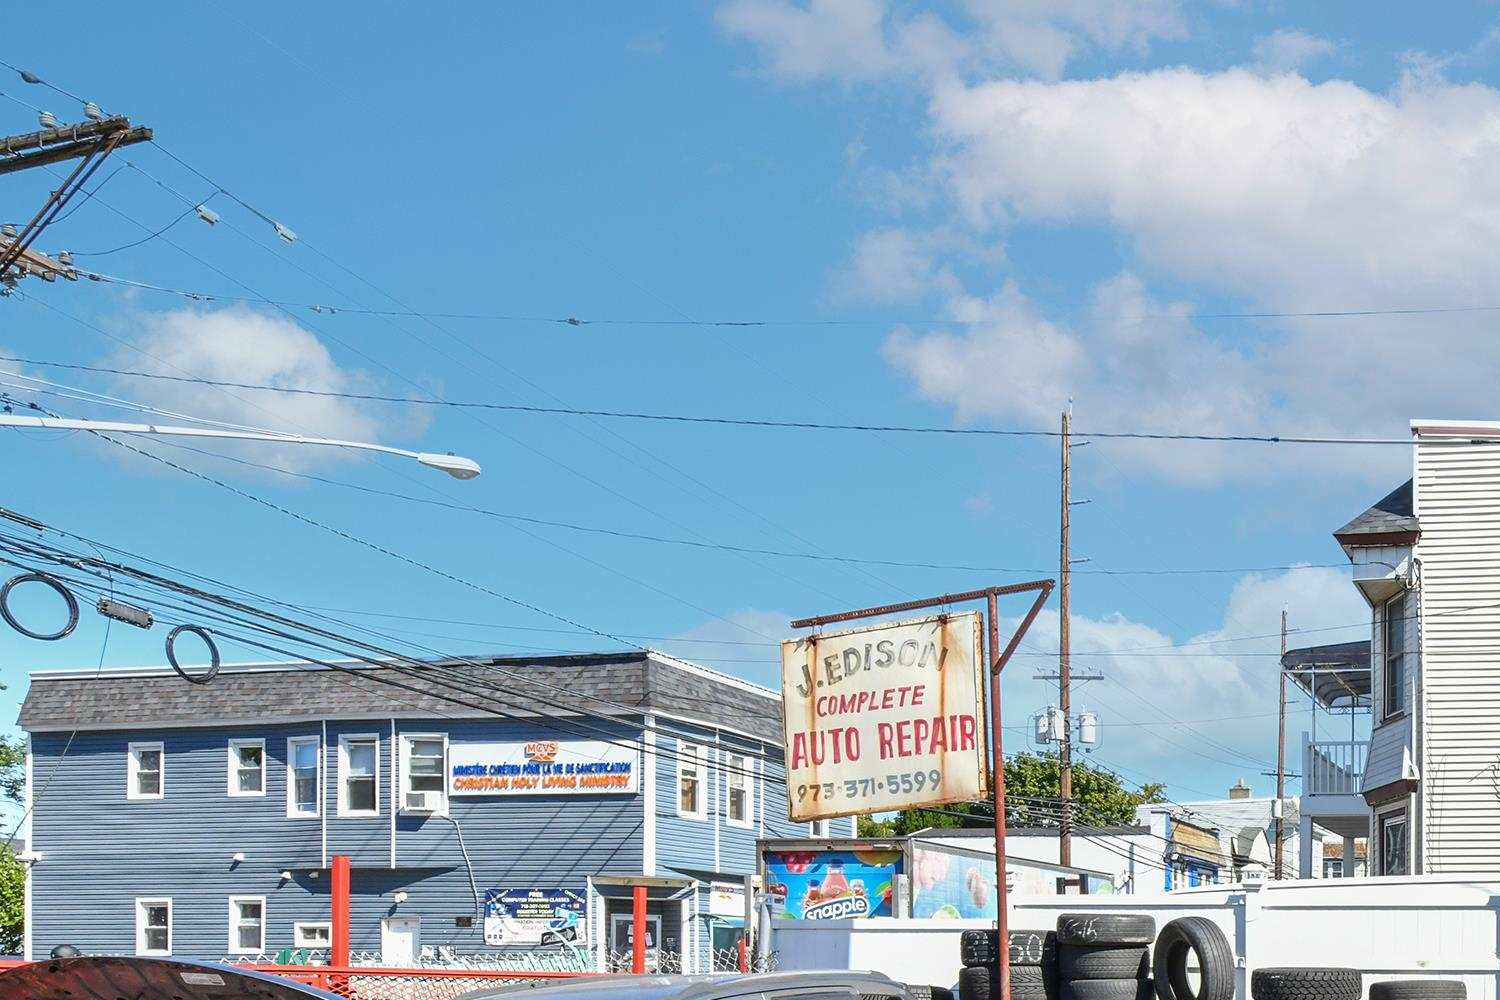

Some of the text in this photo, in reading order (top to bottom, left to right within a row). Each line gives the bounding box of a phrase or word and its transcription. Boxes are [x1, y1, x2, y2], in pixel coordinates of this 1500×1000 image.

[816, 685, 925, 717] COMPLETE
[792, 714, 976, 770] AUTO REPAIR
[542, 763, 551, 775] LA
[552, 763, 563, 775] VIE
[566, 763, 574, 774] DE
[453, 775, 631, 791] CHRISTIAN HOLY LIVING MINISTRY
[805, 897, 866, 919] snapple
